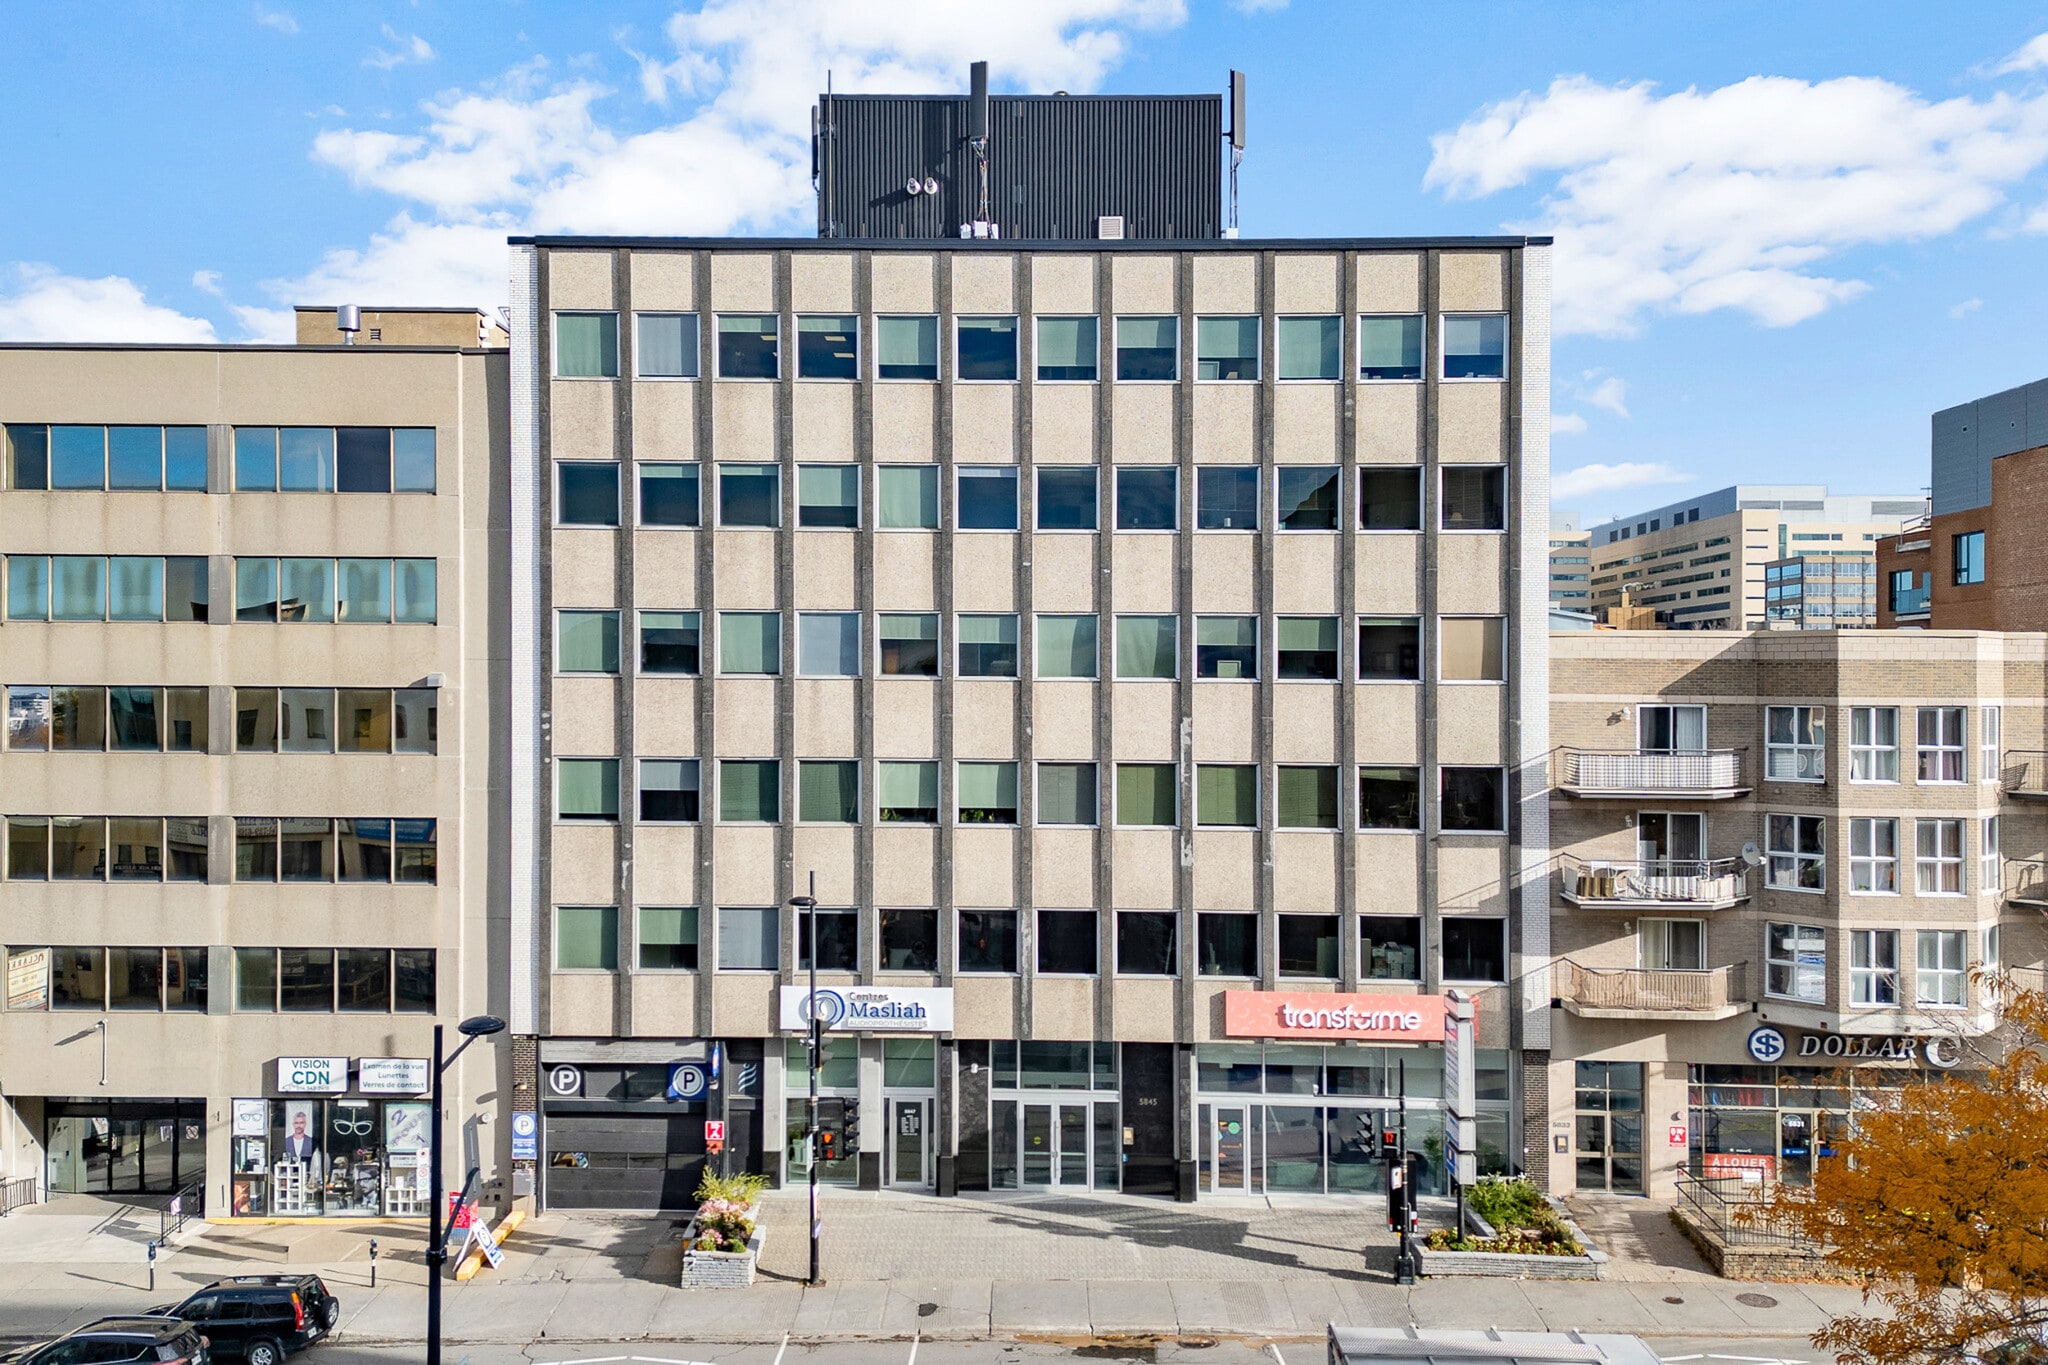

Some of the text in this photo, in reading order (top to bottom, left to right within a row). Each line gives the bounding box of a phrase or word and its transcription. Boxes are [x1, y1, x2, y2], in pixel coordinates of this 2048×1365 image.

[849, 992, 889, 1001] Centres
[850, 1002, 927, 1018] Masliah
[1283, 1003, 1421, 1030] transforme
[1800, 1035, 1917, 1059] DOLLAR
[291, 1059, 330, 1069] VISION
[363, 1062, 391, 1070] Examen
[291, 1071, 330, 1085] CDN
[559, 1070, 574, 1090] P
[683, 1071, 695, 1090] P
[1139, 1097, 1158, 1106] 5845
[520, 1120, 529, 1130] P
[1724, 1157, 1767, 1168] LOUER
